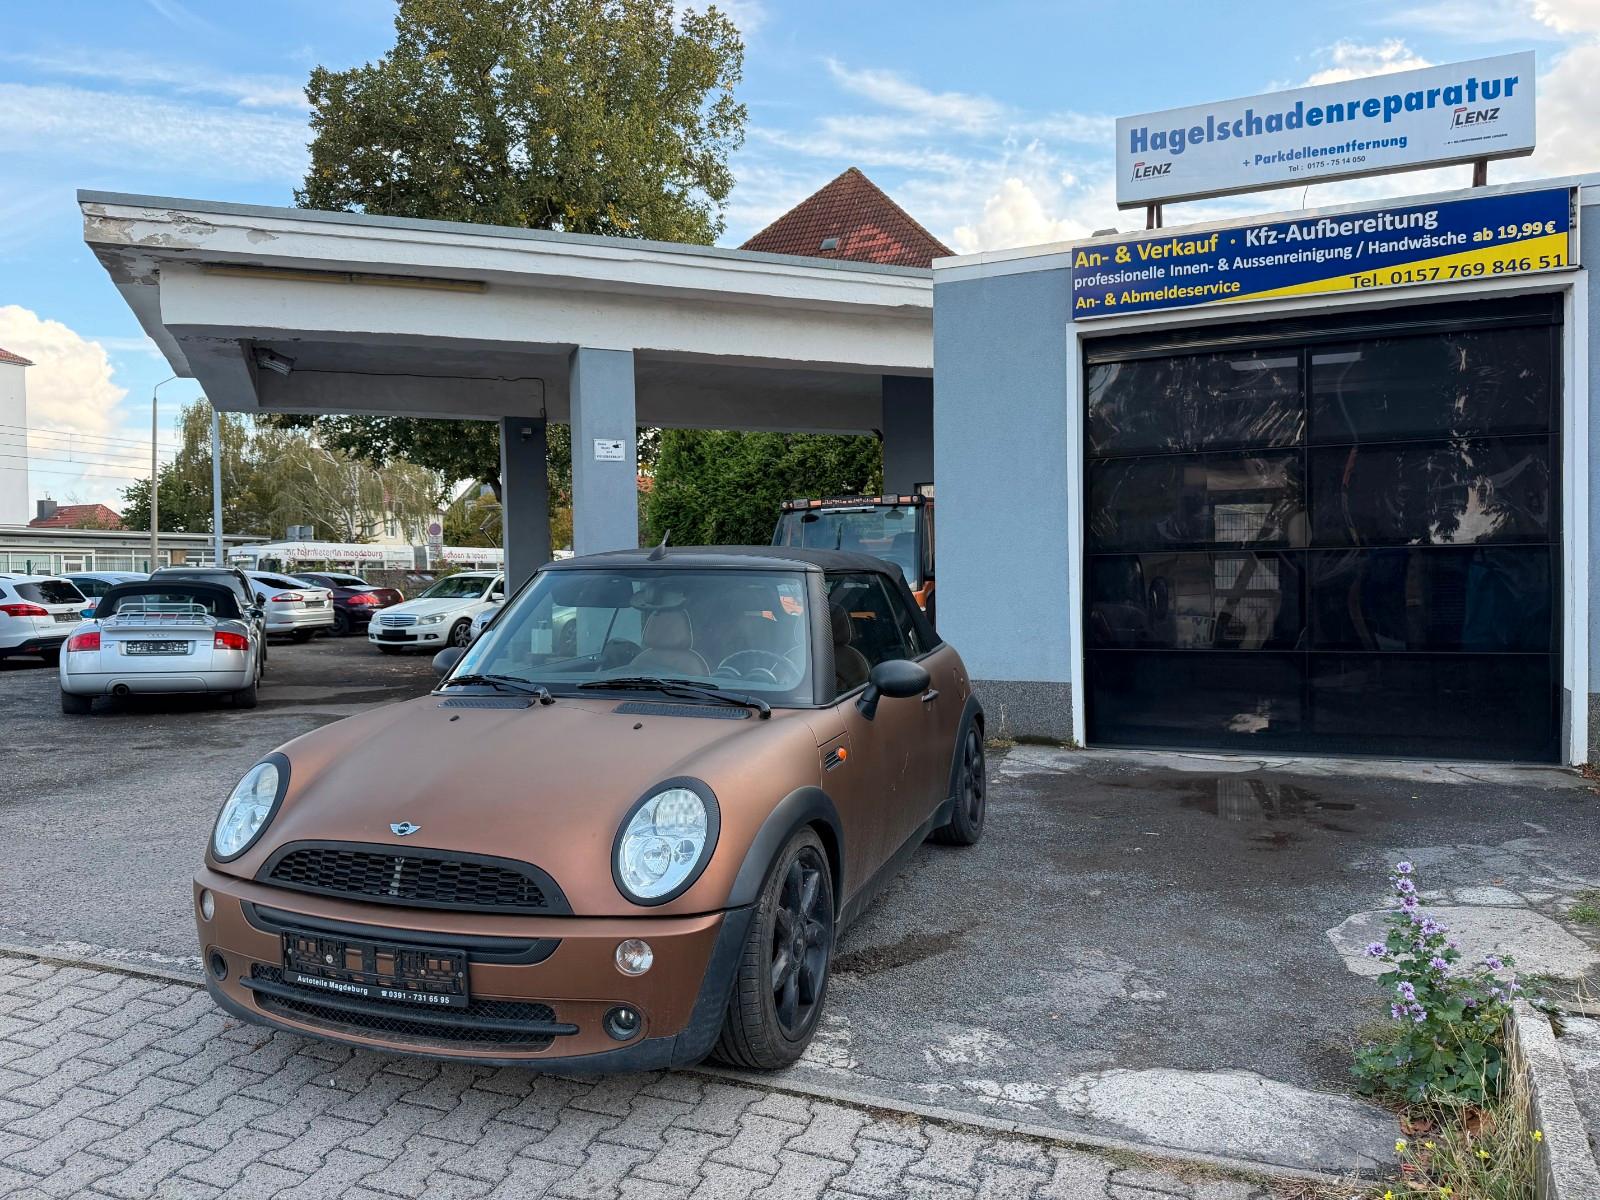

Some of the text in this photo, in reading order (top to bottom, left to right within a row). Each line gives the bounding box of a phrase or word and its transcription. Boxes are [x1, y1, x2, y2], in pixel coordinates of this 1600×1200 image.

[1131, 76, 1518, 154] Hagelschadenreparatur
[1454, 107, 1500, 126] LENZ
[1255, 136, 1408, 165] Parkdellenentfernung
[1307, 161, 1325, 170] 0175
[1341, 157, 1350, 165] 14
[1352, 155, 1366, 163] 050
[1135, 162, 1172, 179] LENZ
[1074, 251, 1109, 269] An-
[1115, 245, 1131, 264] &
[1137, 234, 1218, 261] Verkauf
[1246, 210, 1439, 248] Kfz-Aufbereitung
[1074, 266, 1165, 291] professionelle
[1170, 263, 1213, 276] Innen-
[1217, 257, 1229, 271] &
[1232, 246, 1353, 270] Aussenreinigung
[1356, 241, 1365, 258] /
[1368, 231, 1467, 255] Handwäsche
[1472, 227, 1494, 242] ab
[1075, 253, 1565, 310] An- & Abmeldeservice Tel. 0157 769 846 51
[297, 975, 328, 988] Autoteile
[329, 981, 368, 996] Magdeburg
[388, 990, 406, 1000] 0391
[413, 993, 427, 1002] 731
